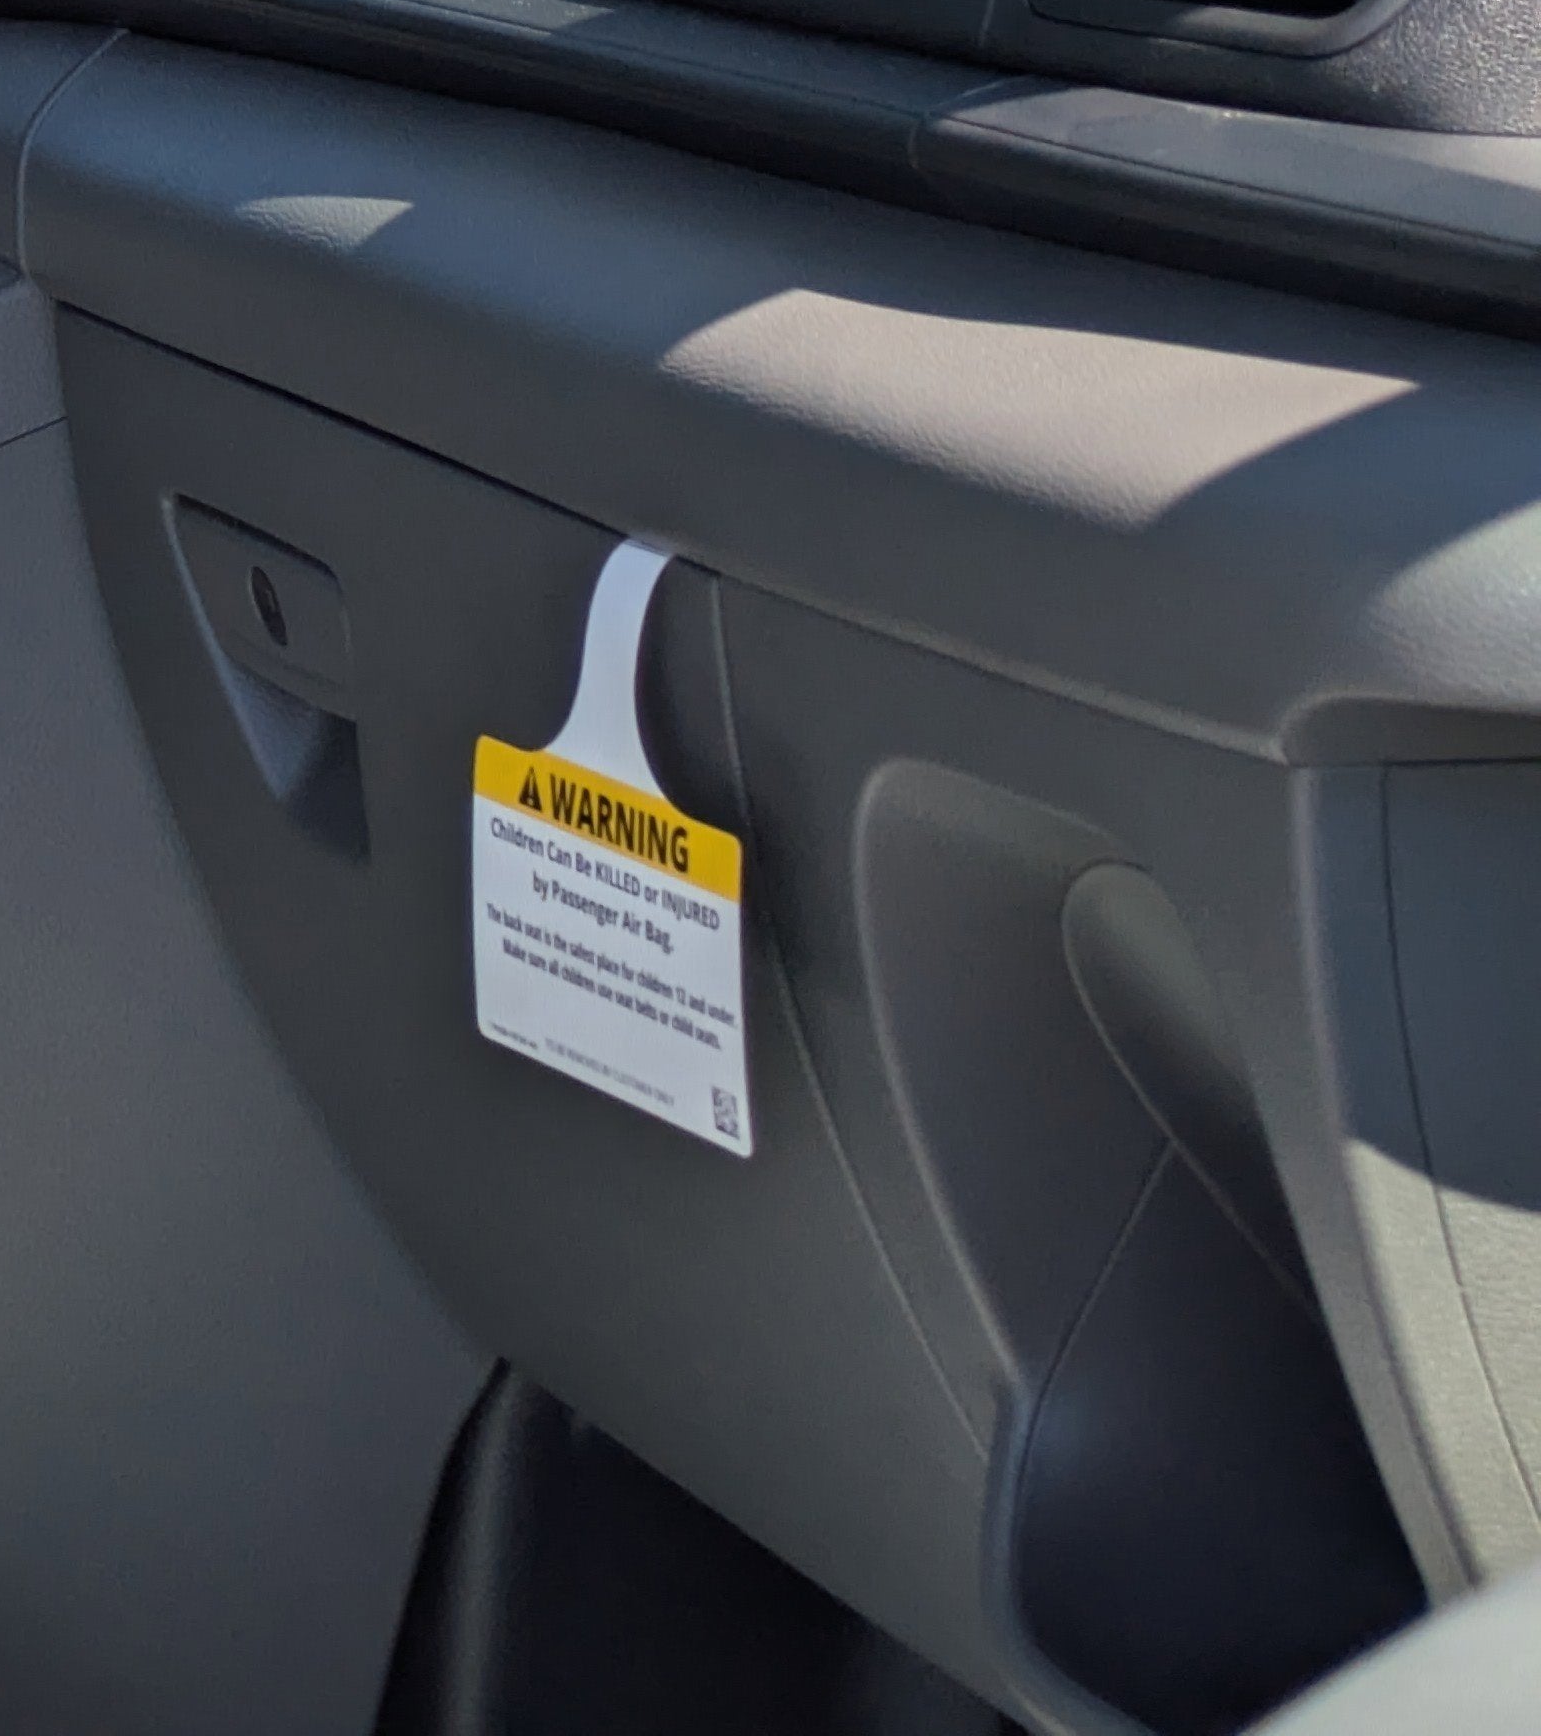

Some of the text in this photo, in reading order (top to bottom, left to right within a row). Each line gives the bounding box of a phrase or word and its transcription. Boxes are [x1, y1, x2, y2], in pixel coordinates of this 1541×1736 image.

[490, 816, 721, 931] Children Can Be KILLED or INJURED
[549, 772, 689, 874] WARNING
[532, 869, 674, 955] by Passenger Air Bag.
